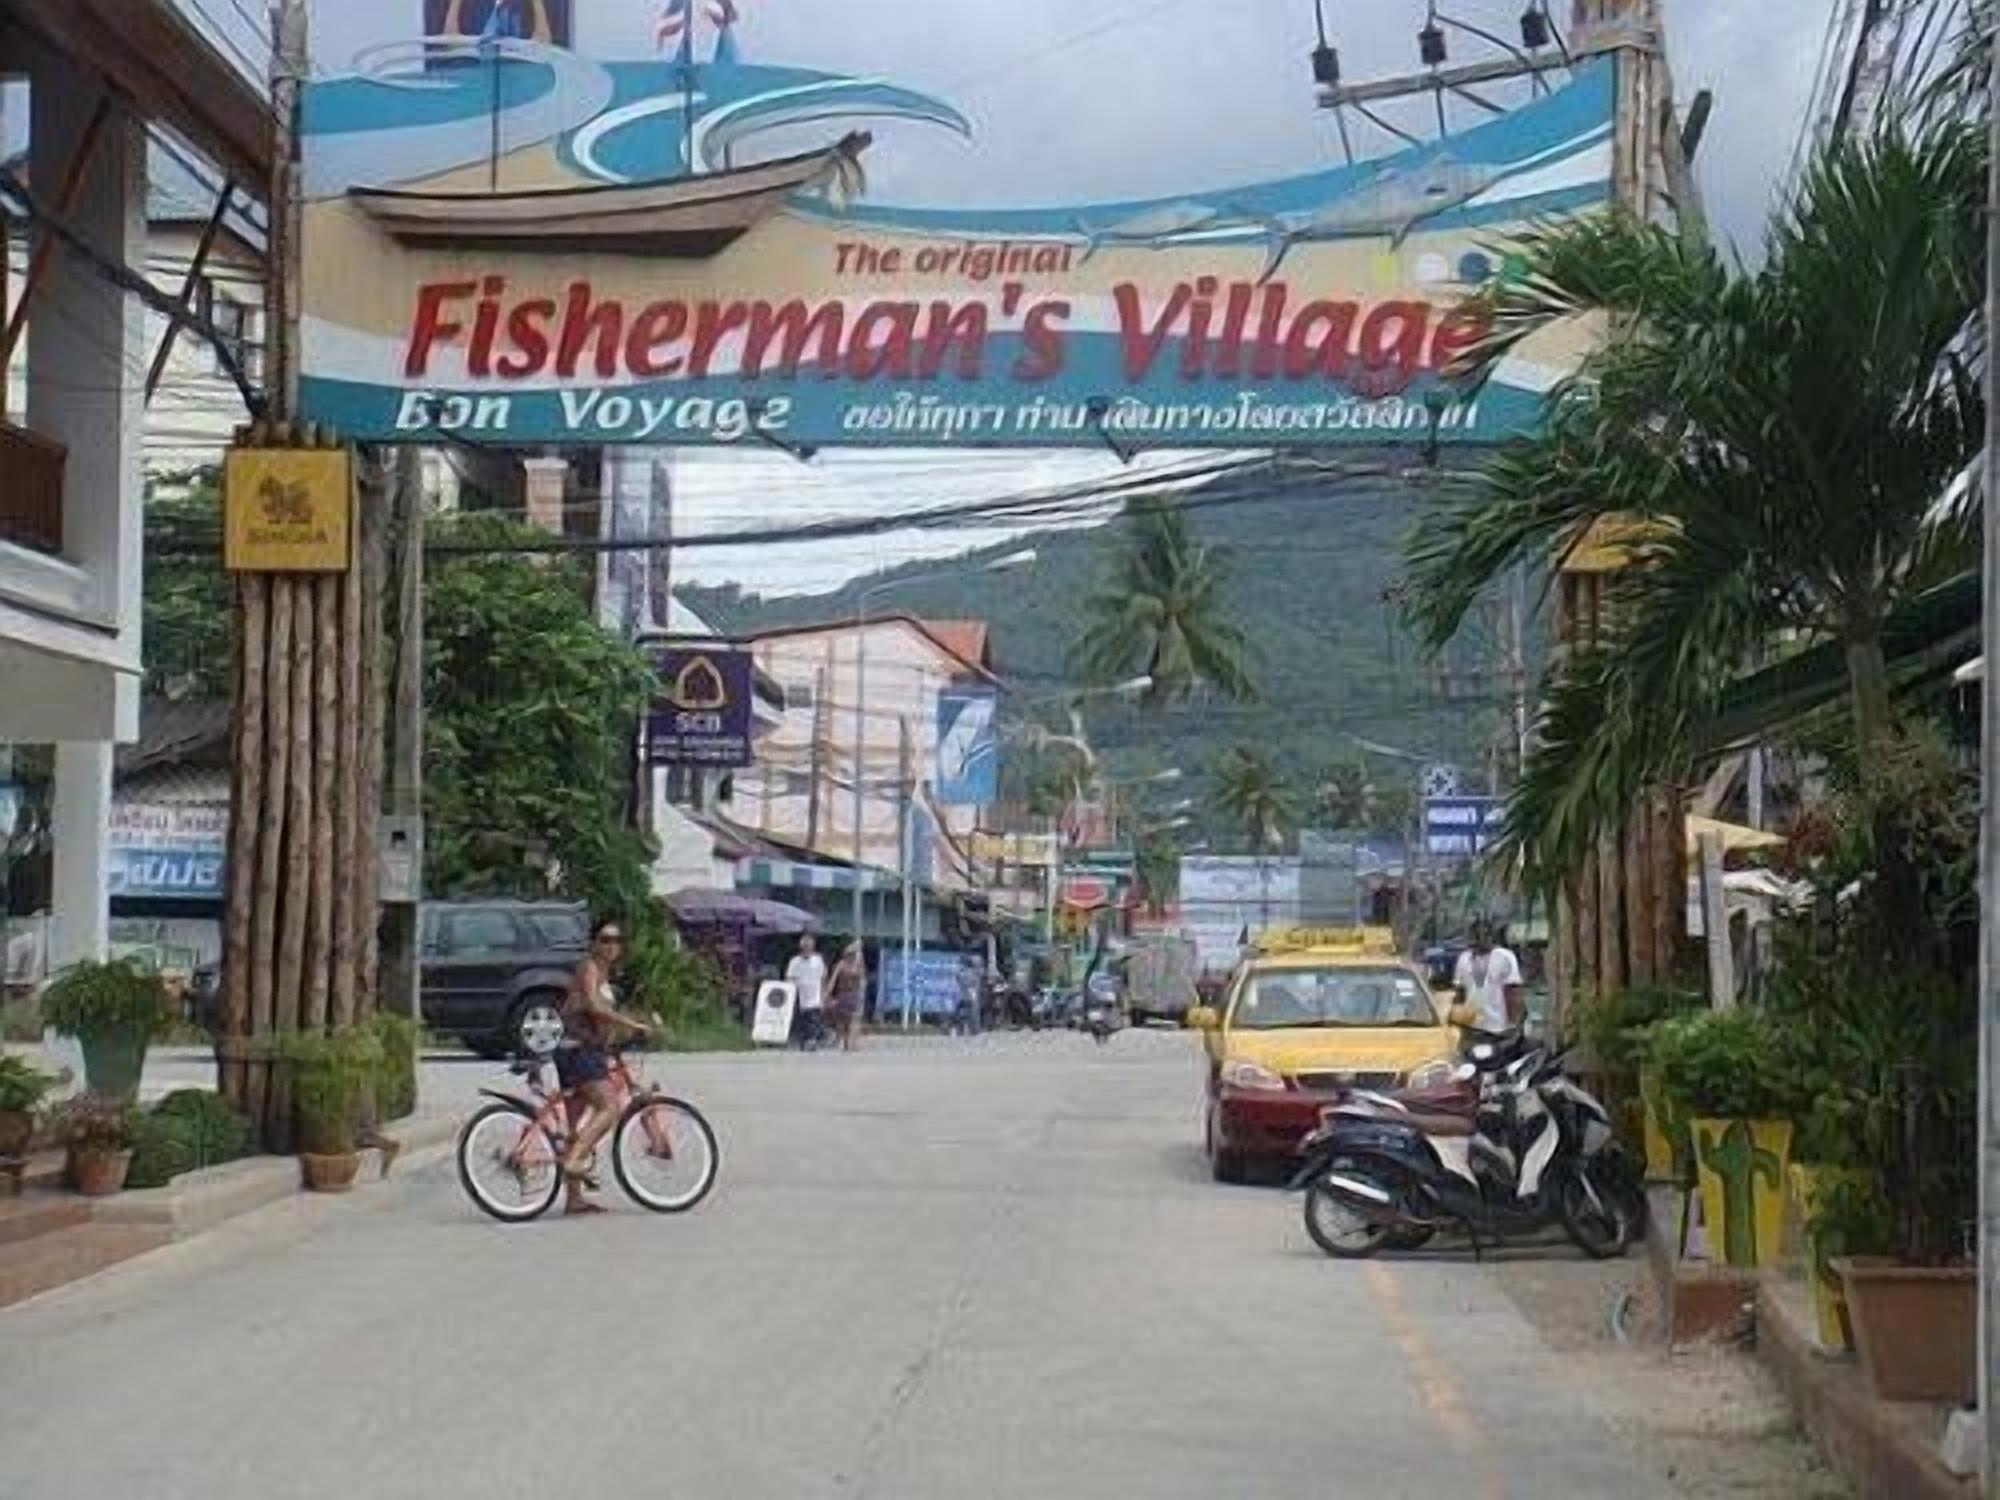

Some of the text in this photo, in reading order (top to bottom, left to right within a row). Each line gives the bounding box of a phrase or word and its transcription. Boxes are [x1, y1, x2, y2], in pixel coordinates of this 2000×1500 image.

[836, 241, 1073, 281] The original
[402, 274, 1494, 398] Fisherman's Village
[559, 389, 793, 441] Voyage
